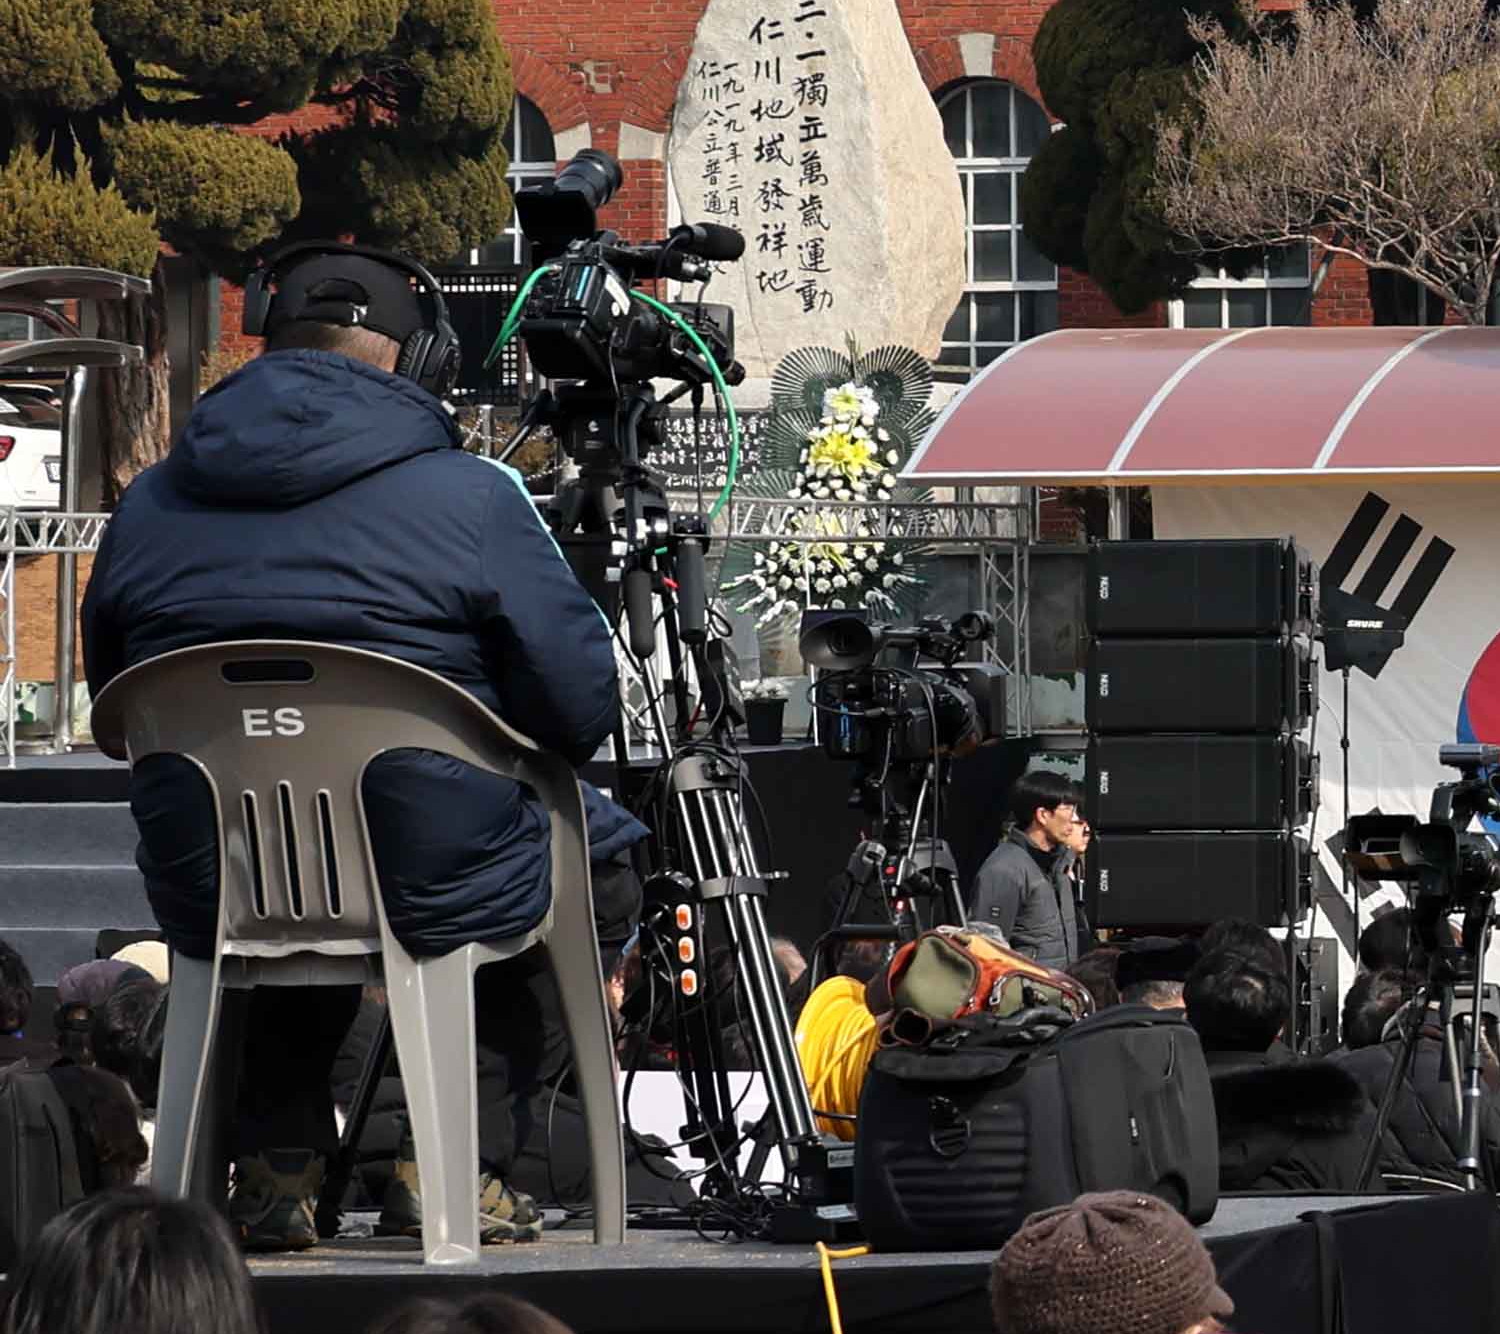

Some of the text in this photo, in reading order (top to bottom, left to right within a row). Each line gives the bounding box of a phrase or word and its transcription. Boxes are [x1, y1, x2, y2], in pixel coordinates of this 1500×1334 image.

[748, 16, 795, 294] 仁川地域發祥地
[242, 707, 305, 736] ES
